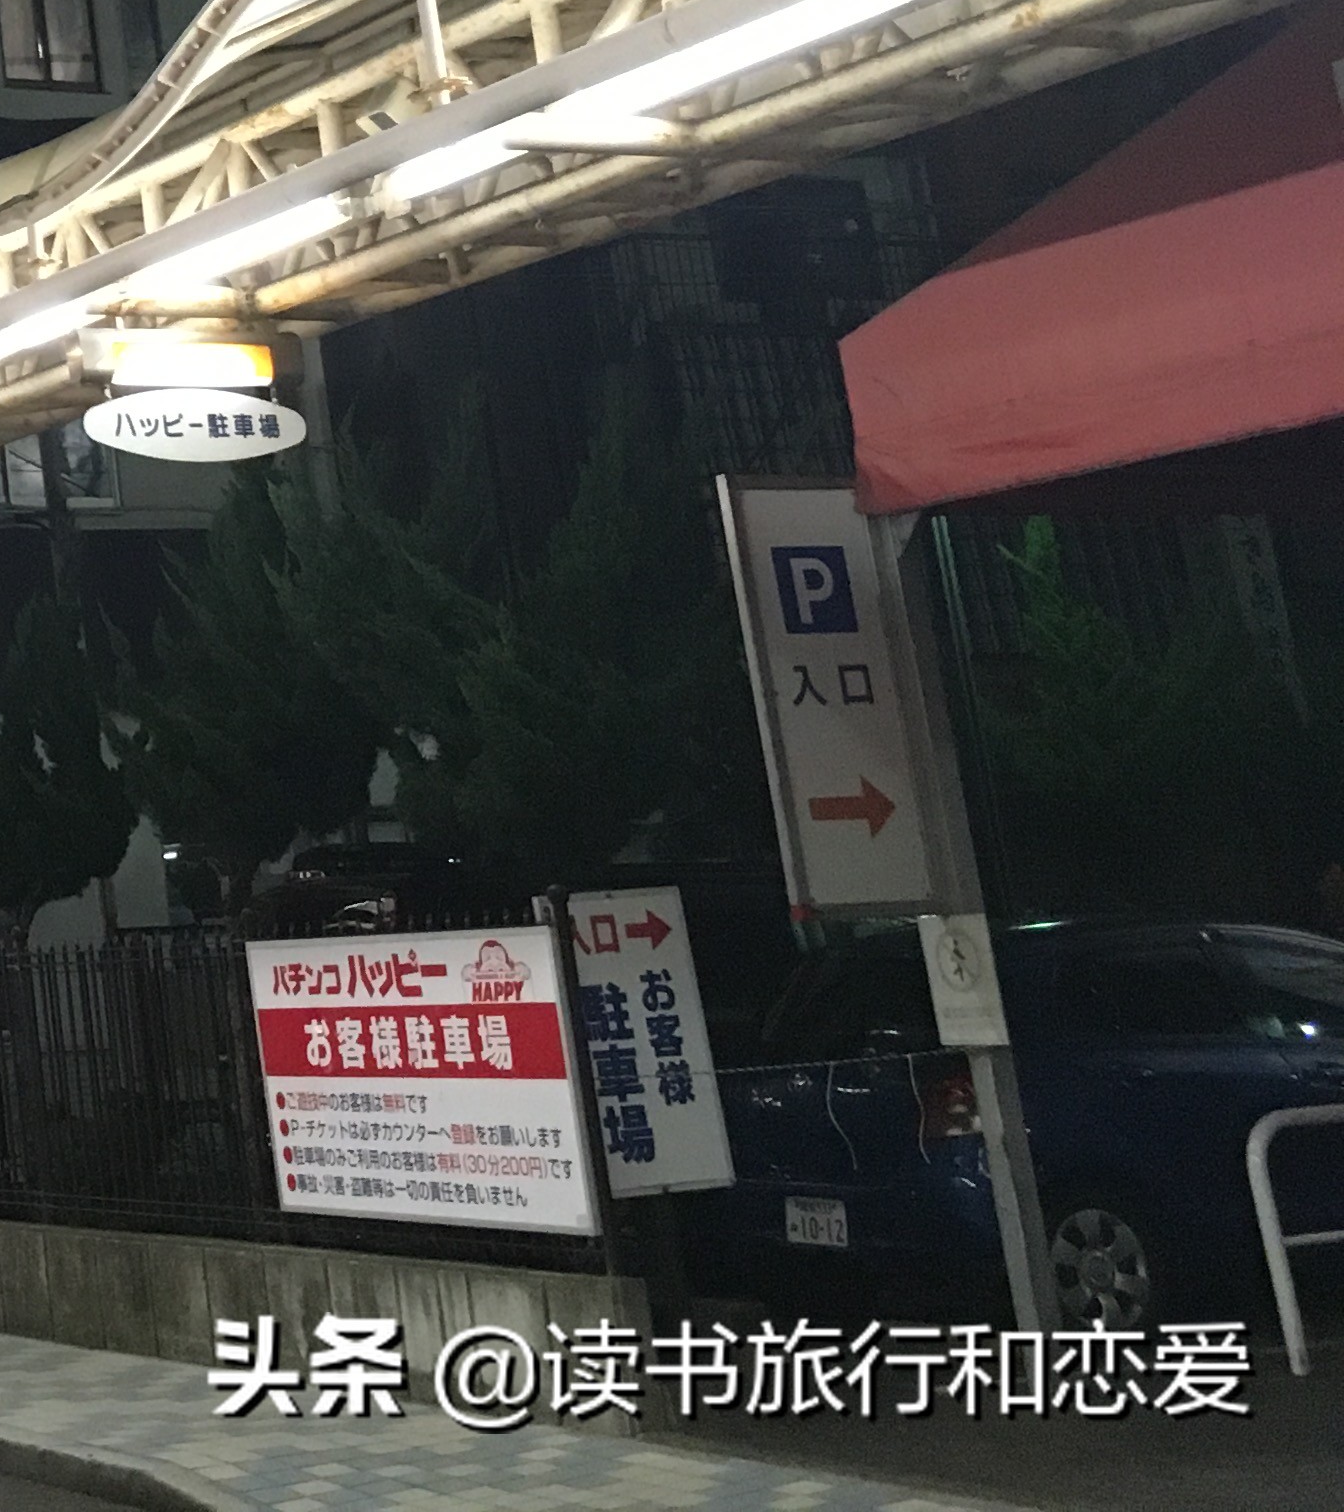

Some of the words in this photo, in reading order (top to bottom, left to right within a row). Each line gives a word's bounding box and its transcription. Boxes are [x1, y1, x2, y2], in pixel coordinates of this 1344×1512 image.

[115, 413, 281, 439] ハッピー駐車場
[789, 557, 833, 625] P
[792, 663, 875, 706] 入口
[272, 962, 340, 997] パチンコ
[347, 949, 447, 999] ハッピー
[472, 980, 525, 1002] HAPPY
[305, 1014, 514, 1071] お客様駐車場
[639, 968, 695, 1106] お客様
[582, 982, 656, 1164] 駐車場
